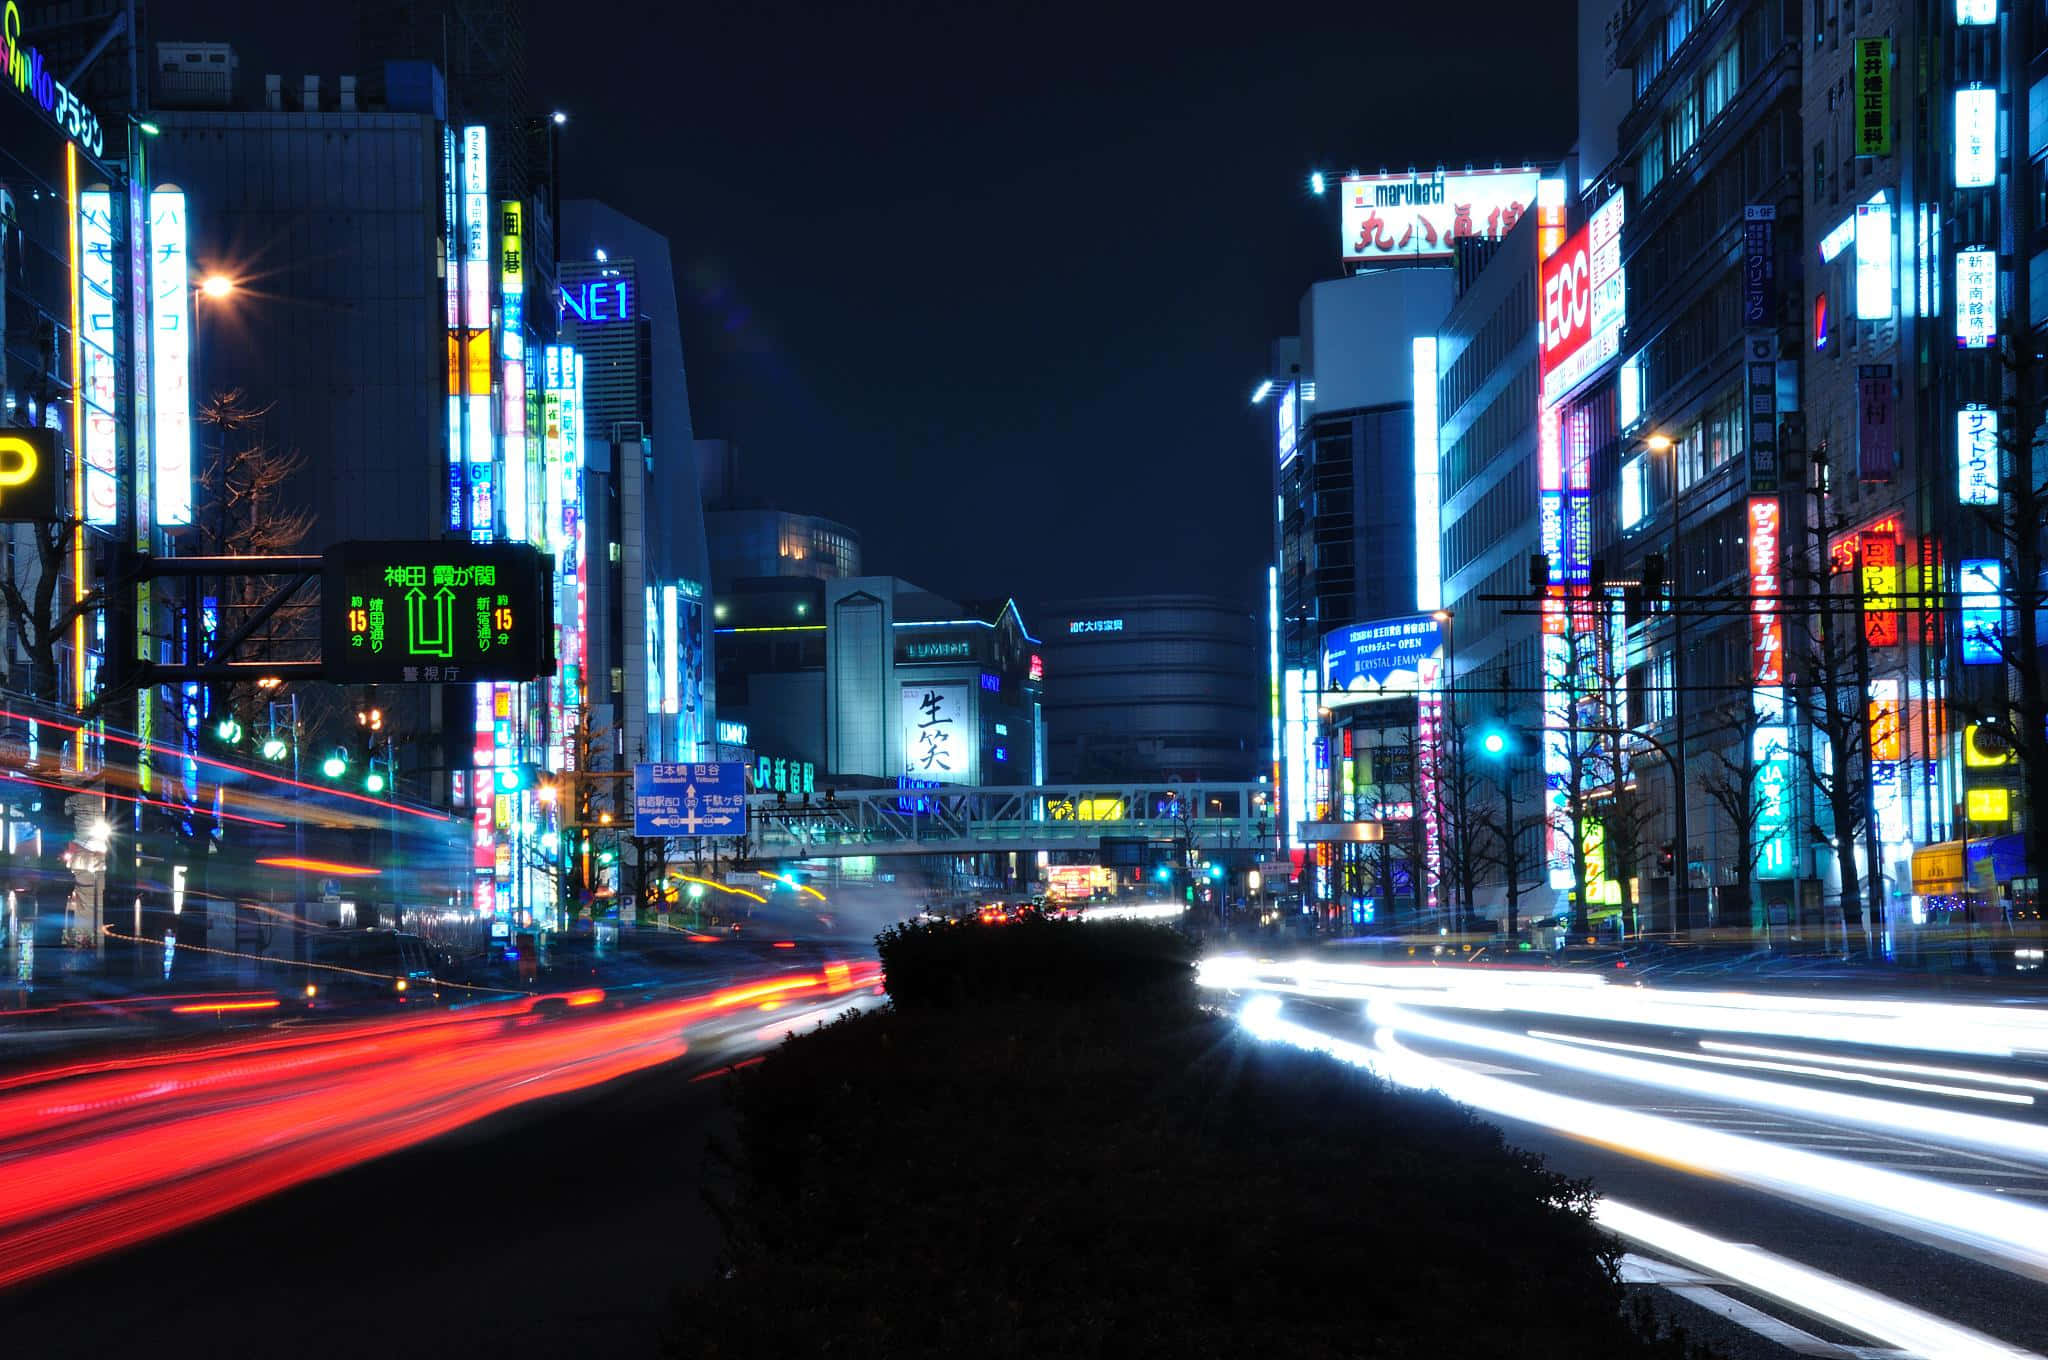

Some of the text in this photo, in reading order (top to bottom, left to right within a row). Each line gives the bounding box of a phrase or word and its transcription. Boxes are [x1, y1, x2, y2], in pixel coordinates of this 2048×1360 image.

[1969, 81, 1983, 90] 5F
[55, 80, 103, 158] アラジン
[1546, 249, 1588, 352] ECC
[1968, 255, 1984, 345] 新宿南診療所
[1966, 403, 1989, 411] 3F
[1968, 413, 1988, 506] サイトウ歯科
[472, 464, 490, 480] 6F
[385, 565, 496, 587] 神田 霞が関
[369, 598, 384, 653] 靖国通り
[476, 597, 491, 652] 新宿通り
[1398, 637, 1422, 649] OPEN
[402, 666, 461, 682] 警視庁
[1361, 656, 1391, 671] CRYSTAL
[653, 764, 719, 777] 日本橋 四谷
[475, 769, 492, 847] アイフル
